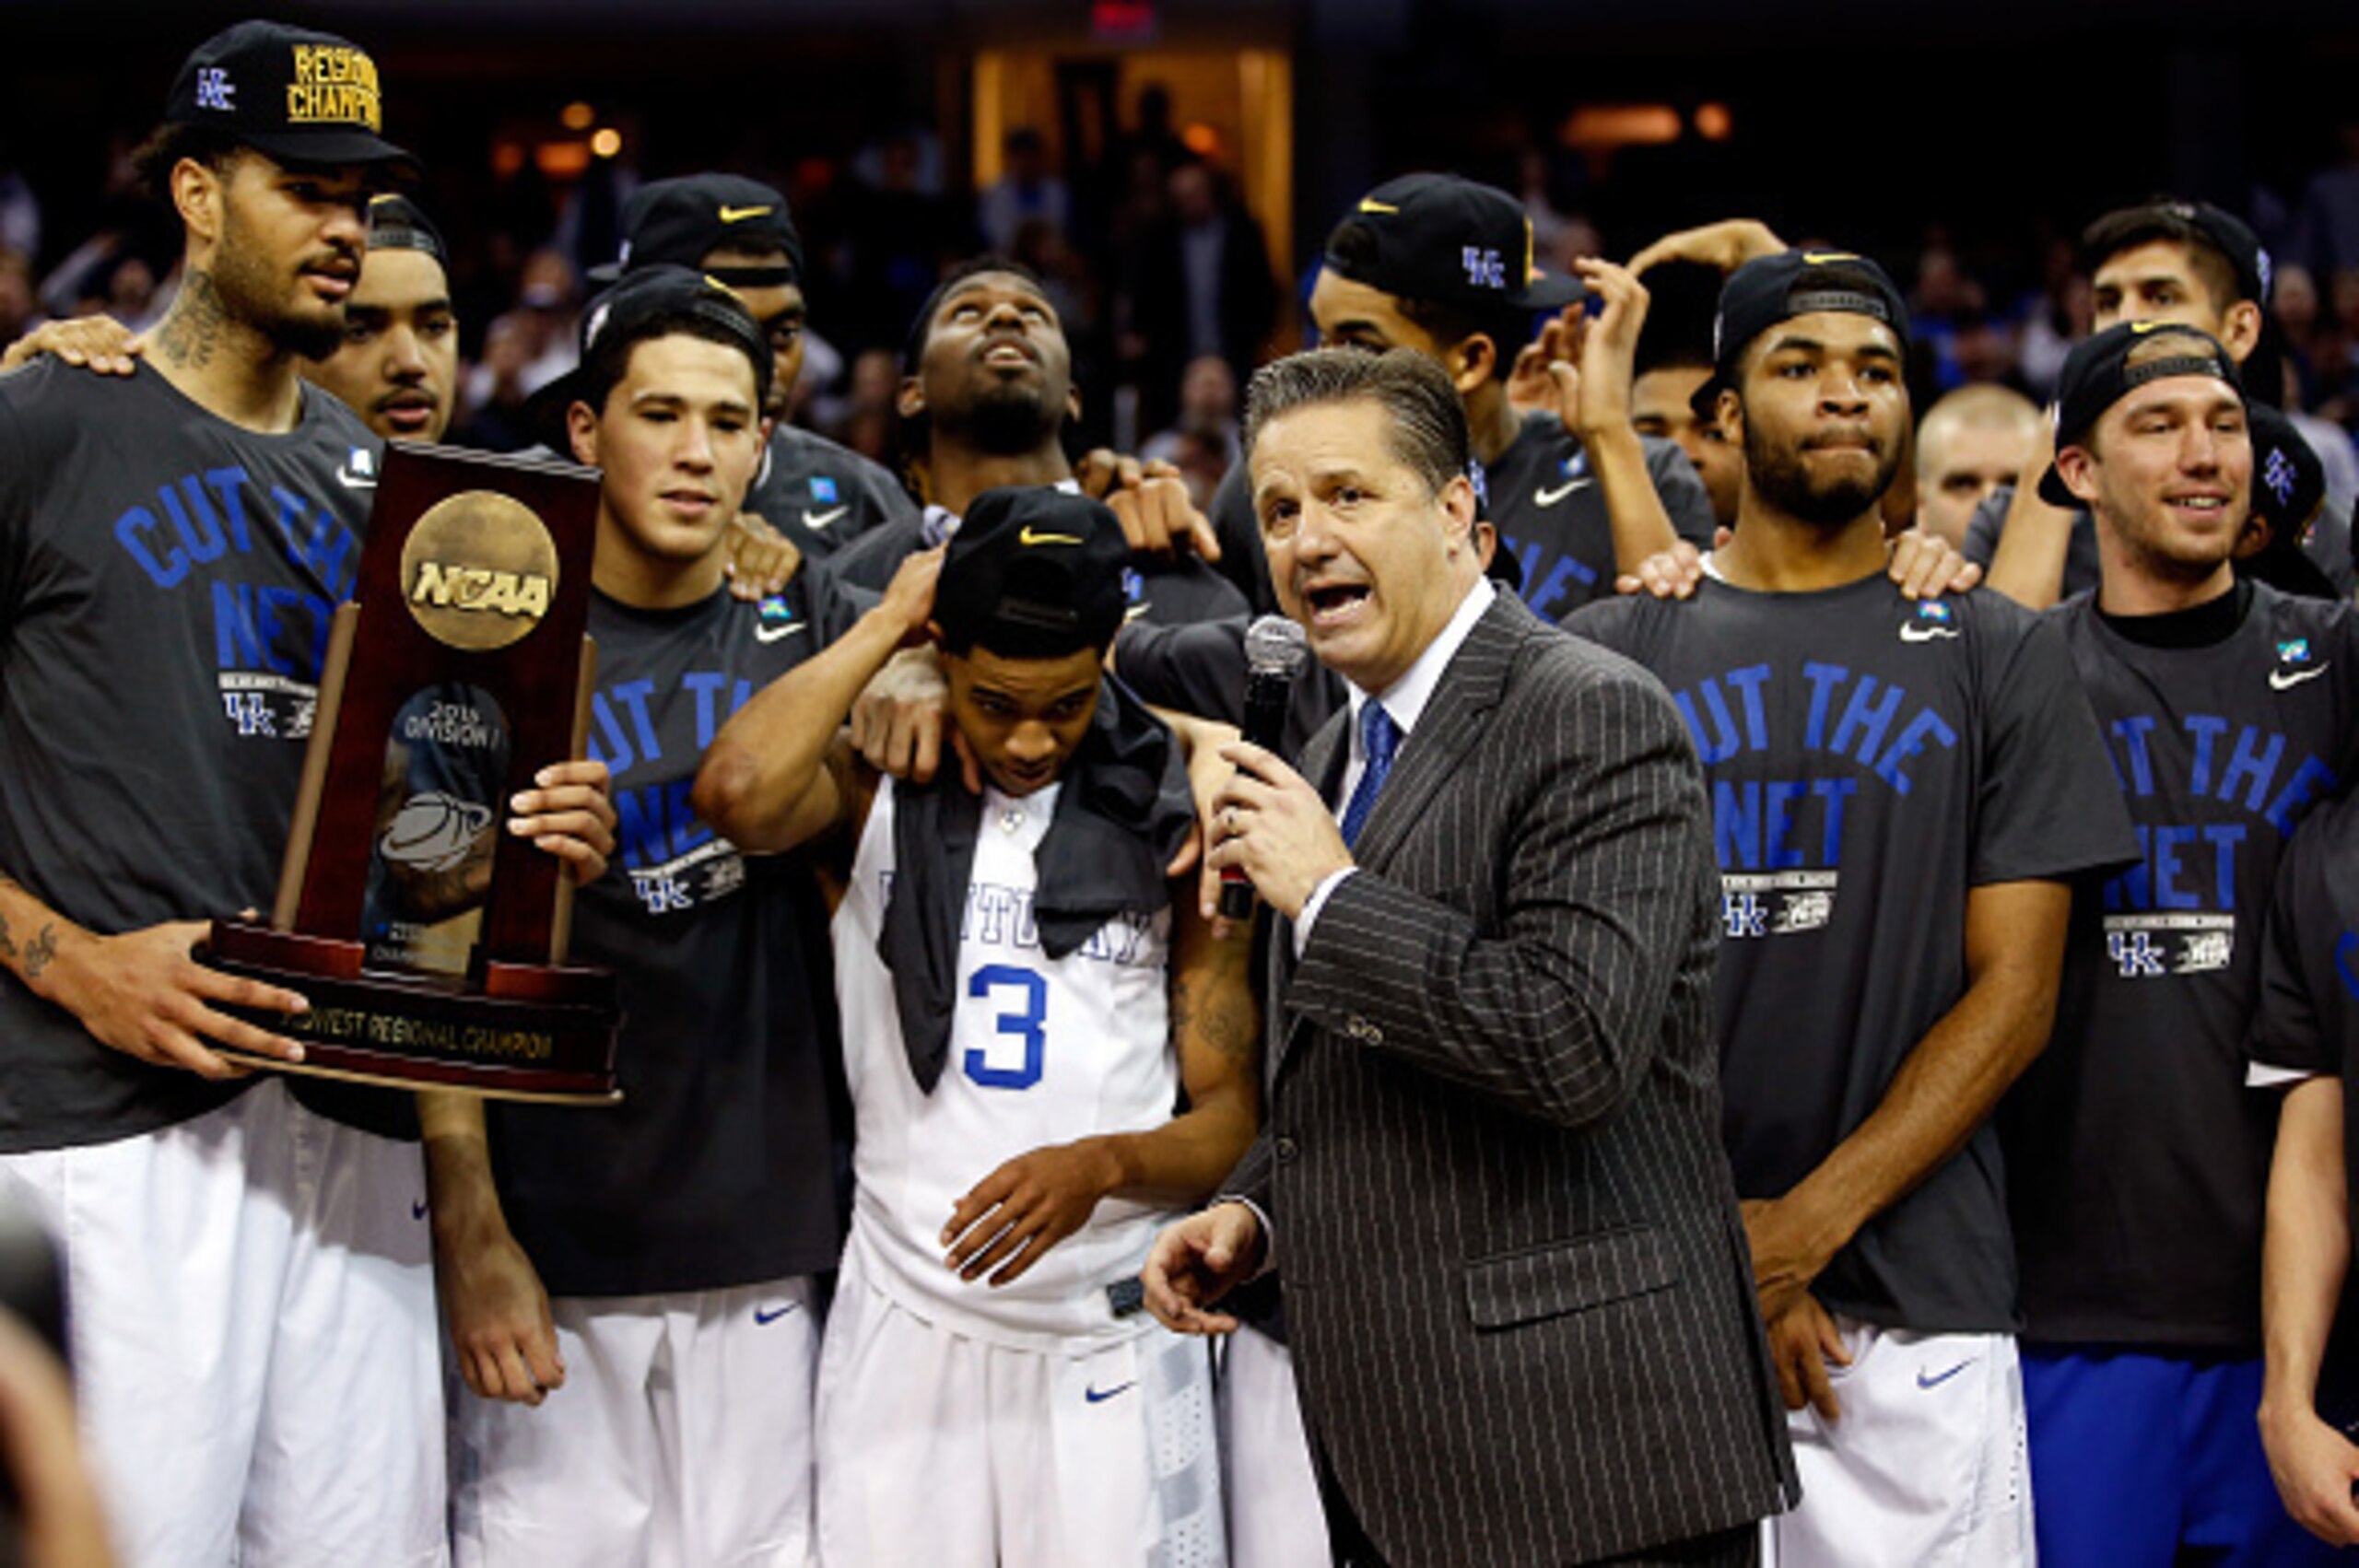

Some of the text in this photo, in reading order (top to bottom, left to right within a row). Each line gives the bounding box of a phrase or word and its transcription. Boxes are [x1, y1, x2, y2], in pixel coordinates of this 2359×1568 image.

[113, 466, 251, 589] CUT
[411, 561, 551, 619] NCAA
[587, 679, 662, 776] UT
[1672, 661, 1958, 796] UT THE
[2184, 712, 2338, 838] THE
[616, 780, 715, 870] NE
[1713, 778, 1858, 869] NET
[964, 965, 1047, 1090] 3
